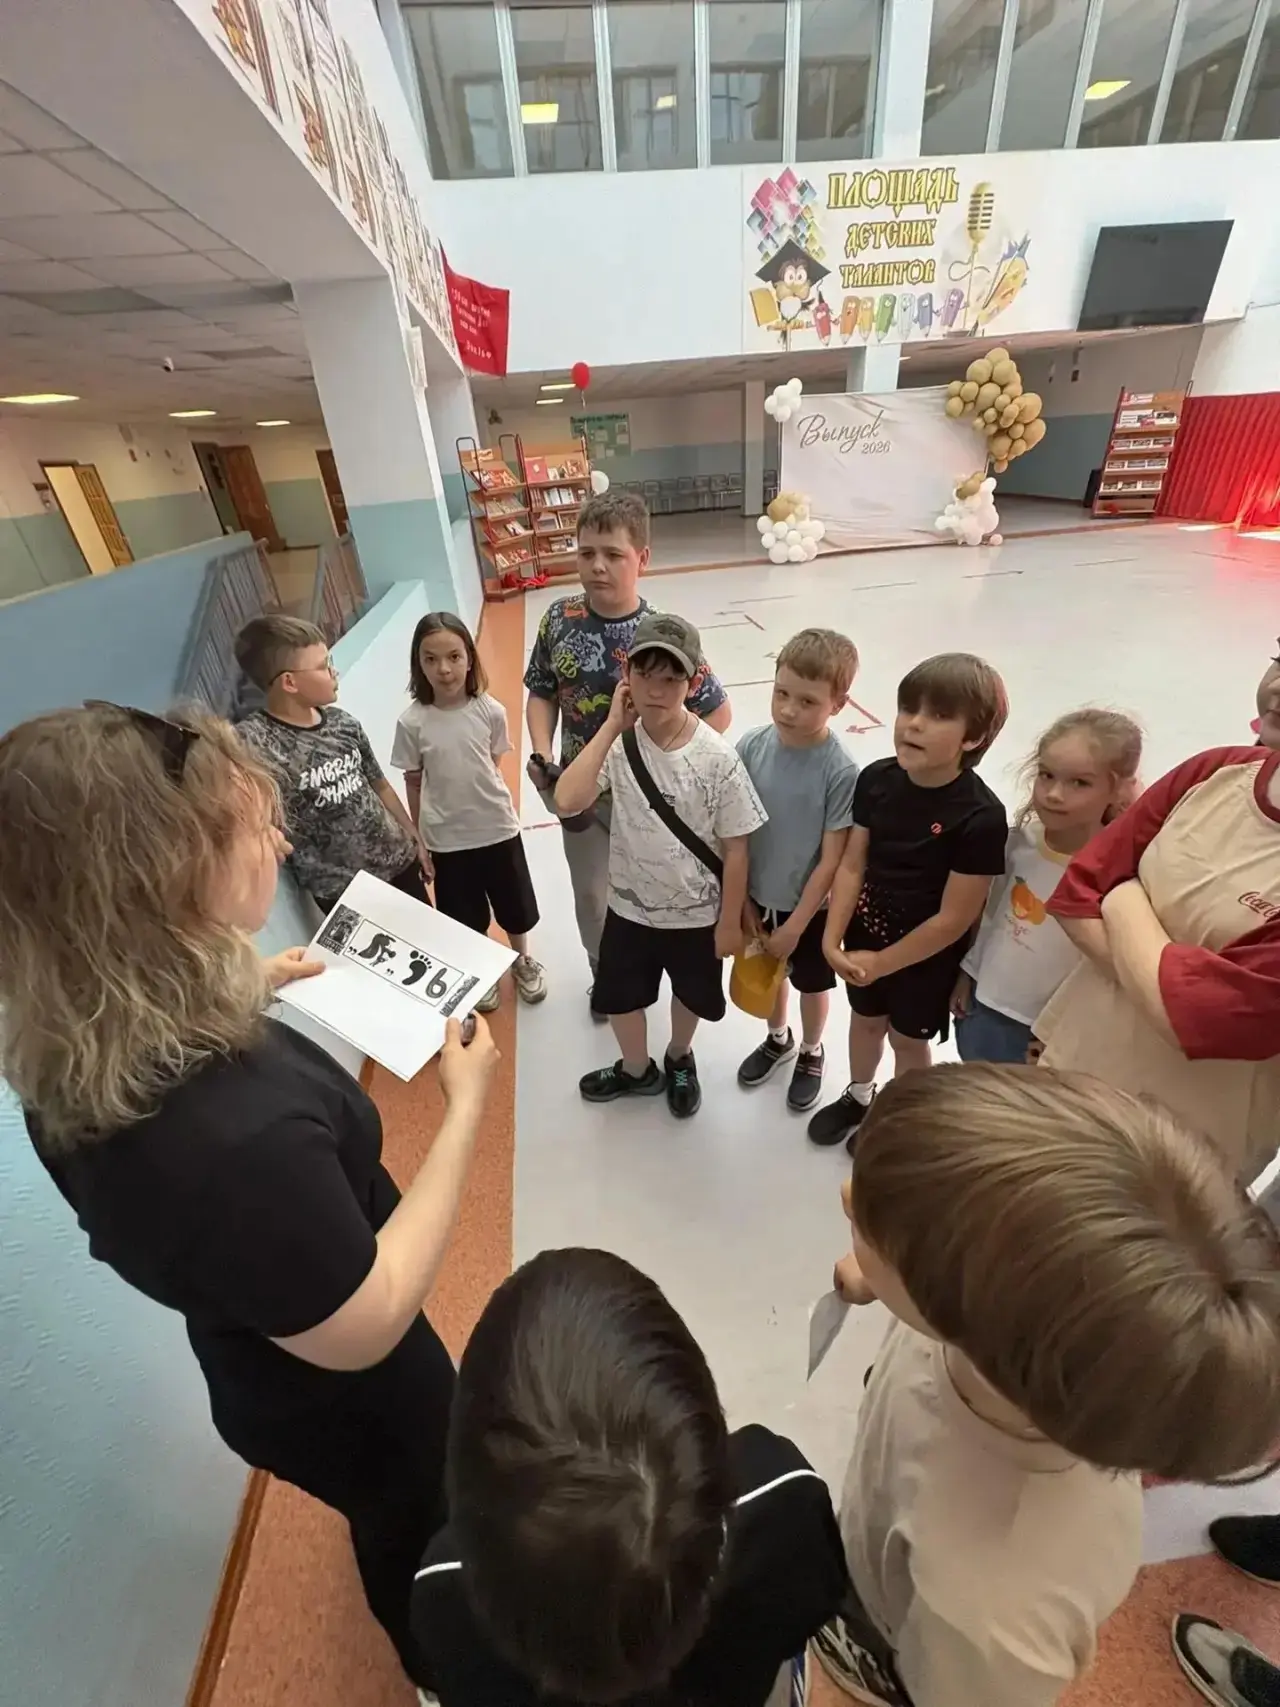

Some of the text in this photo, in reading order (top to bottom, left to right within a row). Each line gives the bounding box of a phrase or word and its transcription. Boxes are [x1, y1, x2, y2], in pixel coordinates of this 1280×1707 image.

[827, 167, 959, 218] ПЛОЩАДЬ
[845, 219, 937, 258] ДЕТСКИХ
[840, 259, 936, 288] ТАЛАНТОВ
[797, 410, 884, 453] Выпуск
[861, 440, 892, 454] 2026
